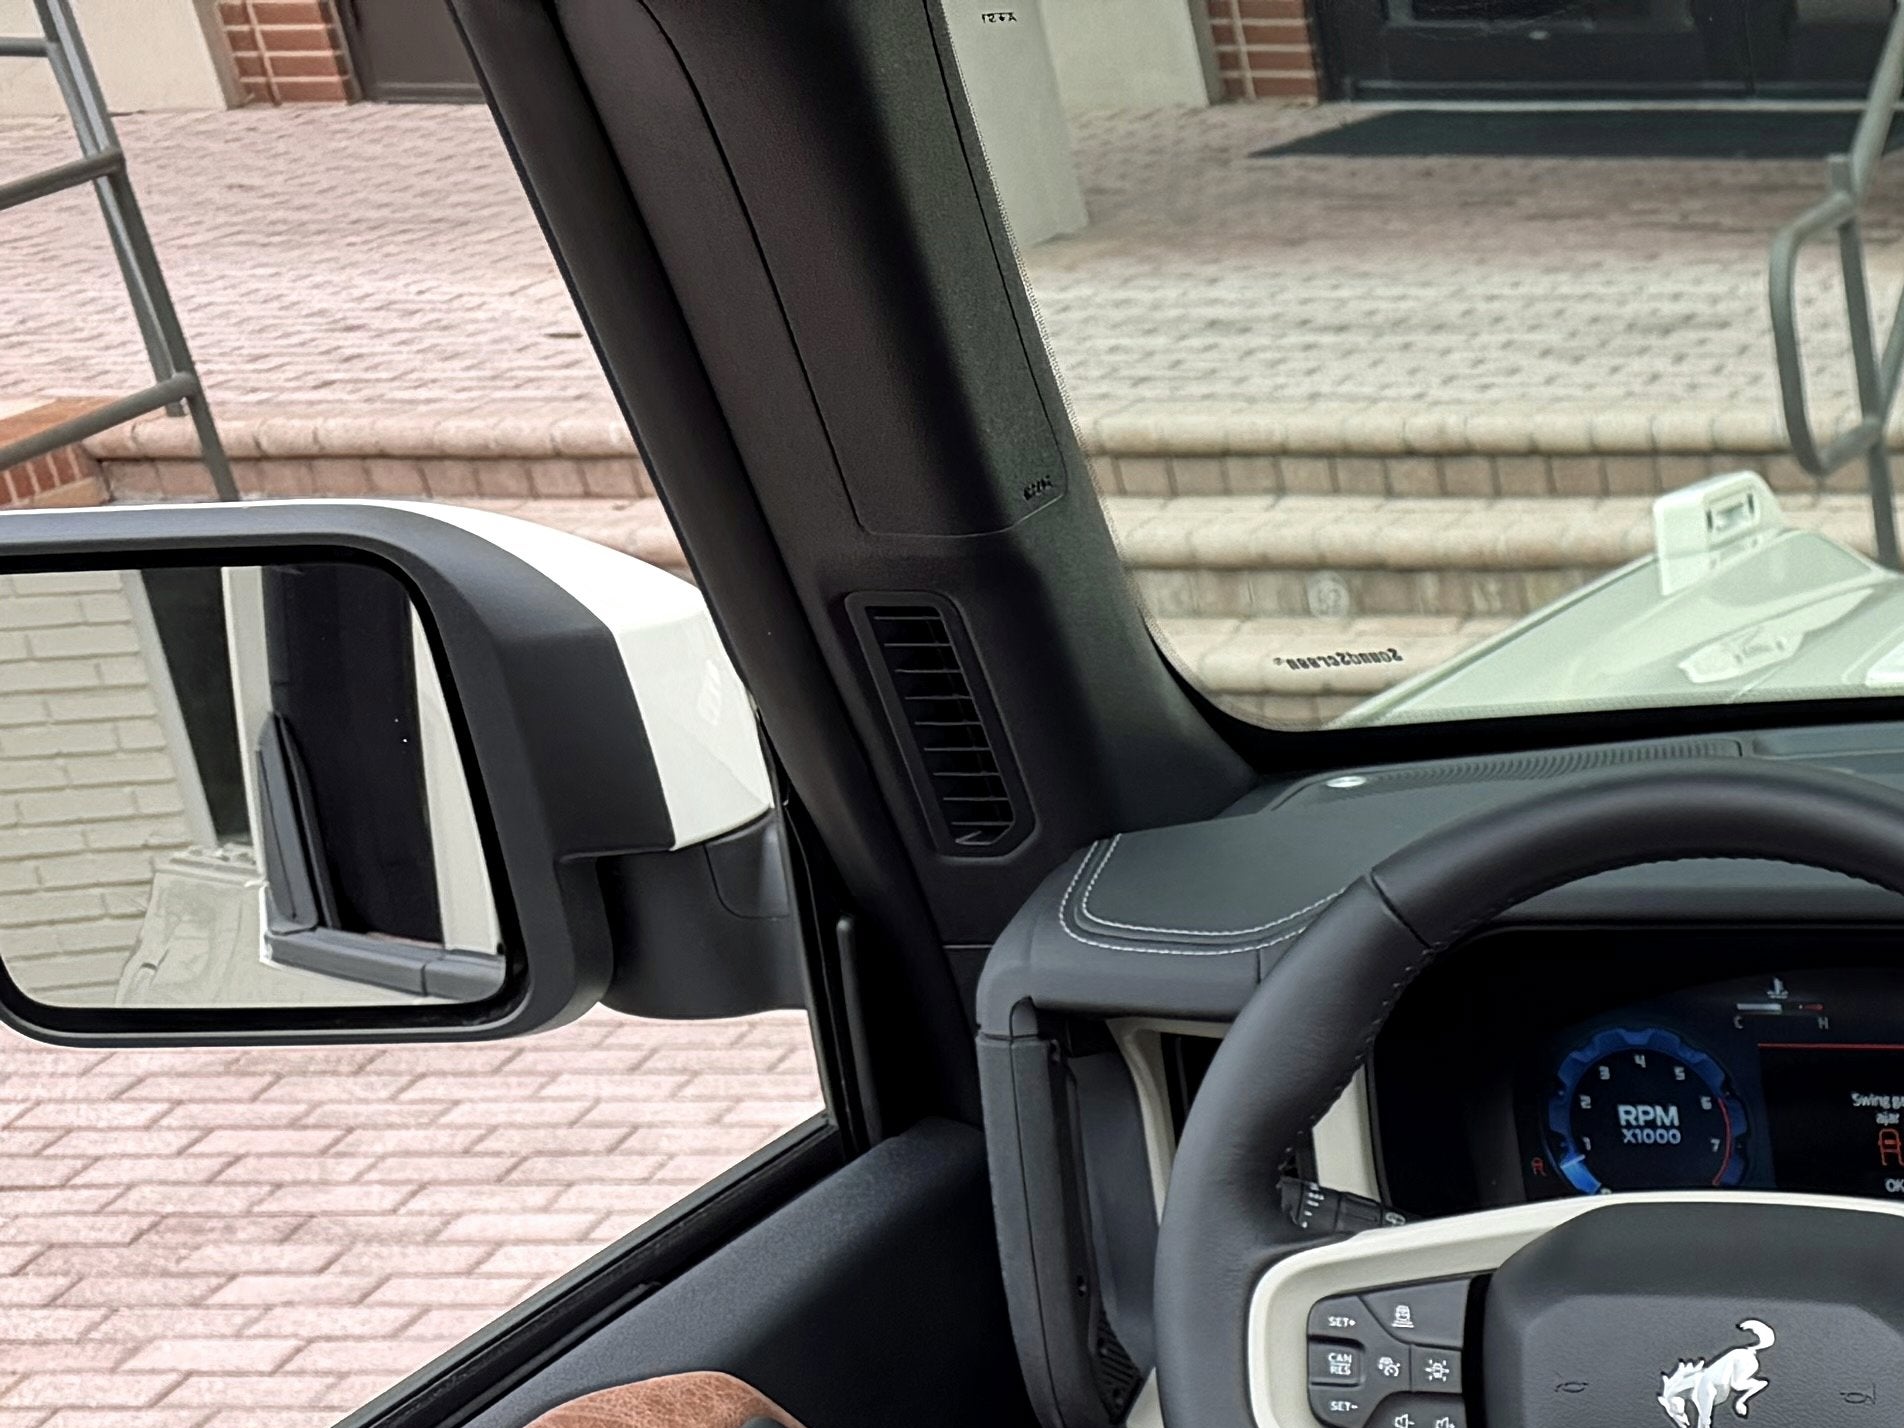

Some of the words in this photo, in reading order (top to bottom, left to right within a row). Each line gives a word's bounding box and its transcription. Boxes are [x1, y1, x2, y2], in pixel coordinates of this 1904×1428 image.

[1818, 1017, 1829, 1030] H
[1634, 1054, 1646, 1068] 4
[1599, 1066, 1610, 1080] 3
[1674, 1066, 1685, 1080] 5
[1580, 1095, 1591, 1109] 2
[1701, 1096, 1712, 1110] 6
[1851, 1092, 1890, 1110] Swing
[1617, 1105, 1680, 1127] RPM
[1583, 1137, 1591, 1151] 1
[1622, 1129, 1681, 1145] X1000
[1711, 1139, 1720, 1152] 7
